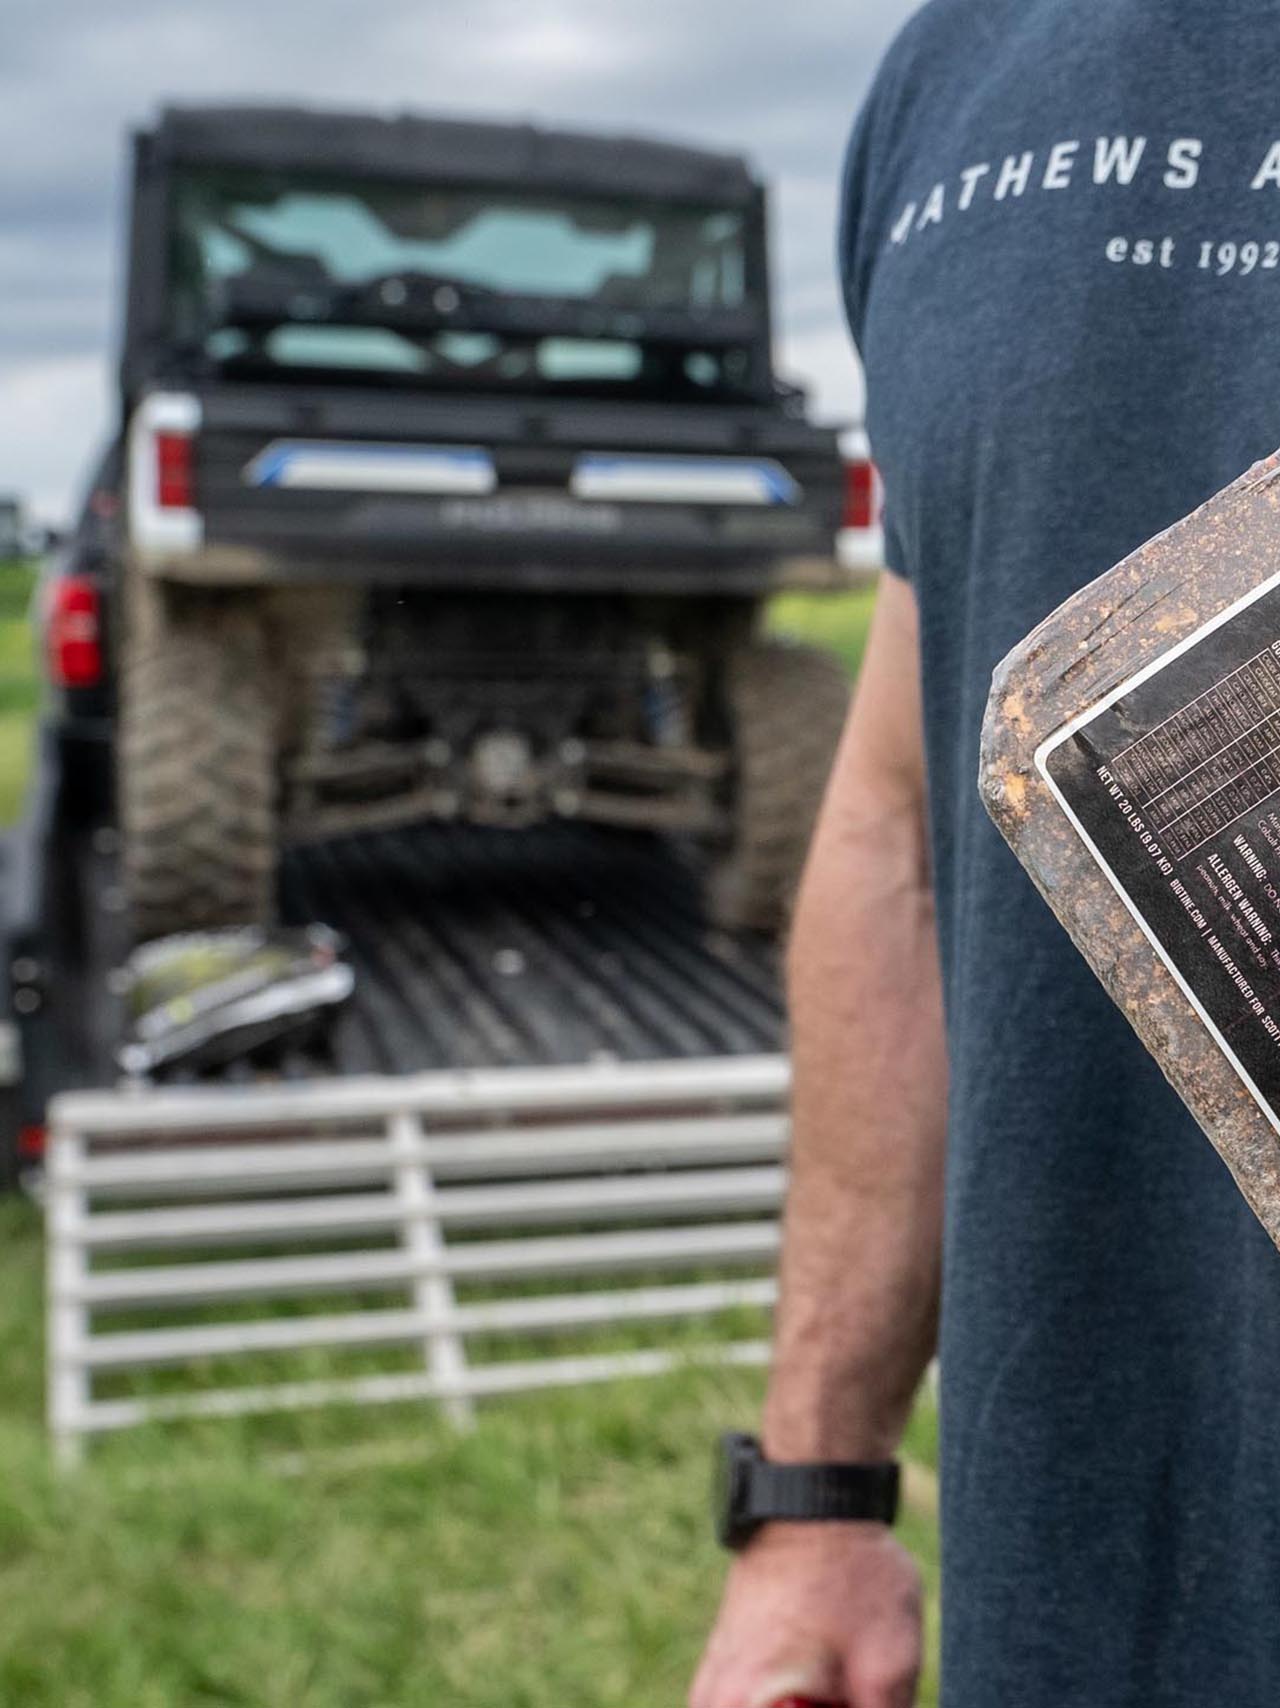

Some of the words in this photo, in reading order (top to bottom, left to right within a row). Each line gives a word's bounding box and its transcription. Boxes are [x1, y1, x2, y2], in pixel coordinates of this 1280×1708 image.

[1105, 235, 1175, 268] est
[1197, 240, 1280, 275] 1992
[1095, 765, 1113, 786] NET
[1107, 783, 1123, 801] WT
[1117, 798, 1132, 814] 20
[1126, 812, 1145, 833] LBS
[1138, 830, 1162, 858] (9.07
[1155, 856, 1173, 876] KG)
[1255, 818, 1279, 847] Cobalt
[1231, 834, 1269, 883] WARNING:
[1262, 883, 1277, 899] DO
[1206, 852, 1243, 901] ALLERGEN
[1236, 897, 1274, 947] WARNING:
[1169, 878, 1207, 929] BIGTINE.COM
[1206, 934, 1254, 999] MANUFACTURED
[1248, 996, 1265, 1015] FOR
[1228, 912, 1250, 938] wheat
[1245, 936, 1260, 954] and
